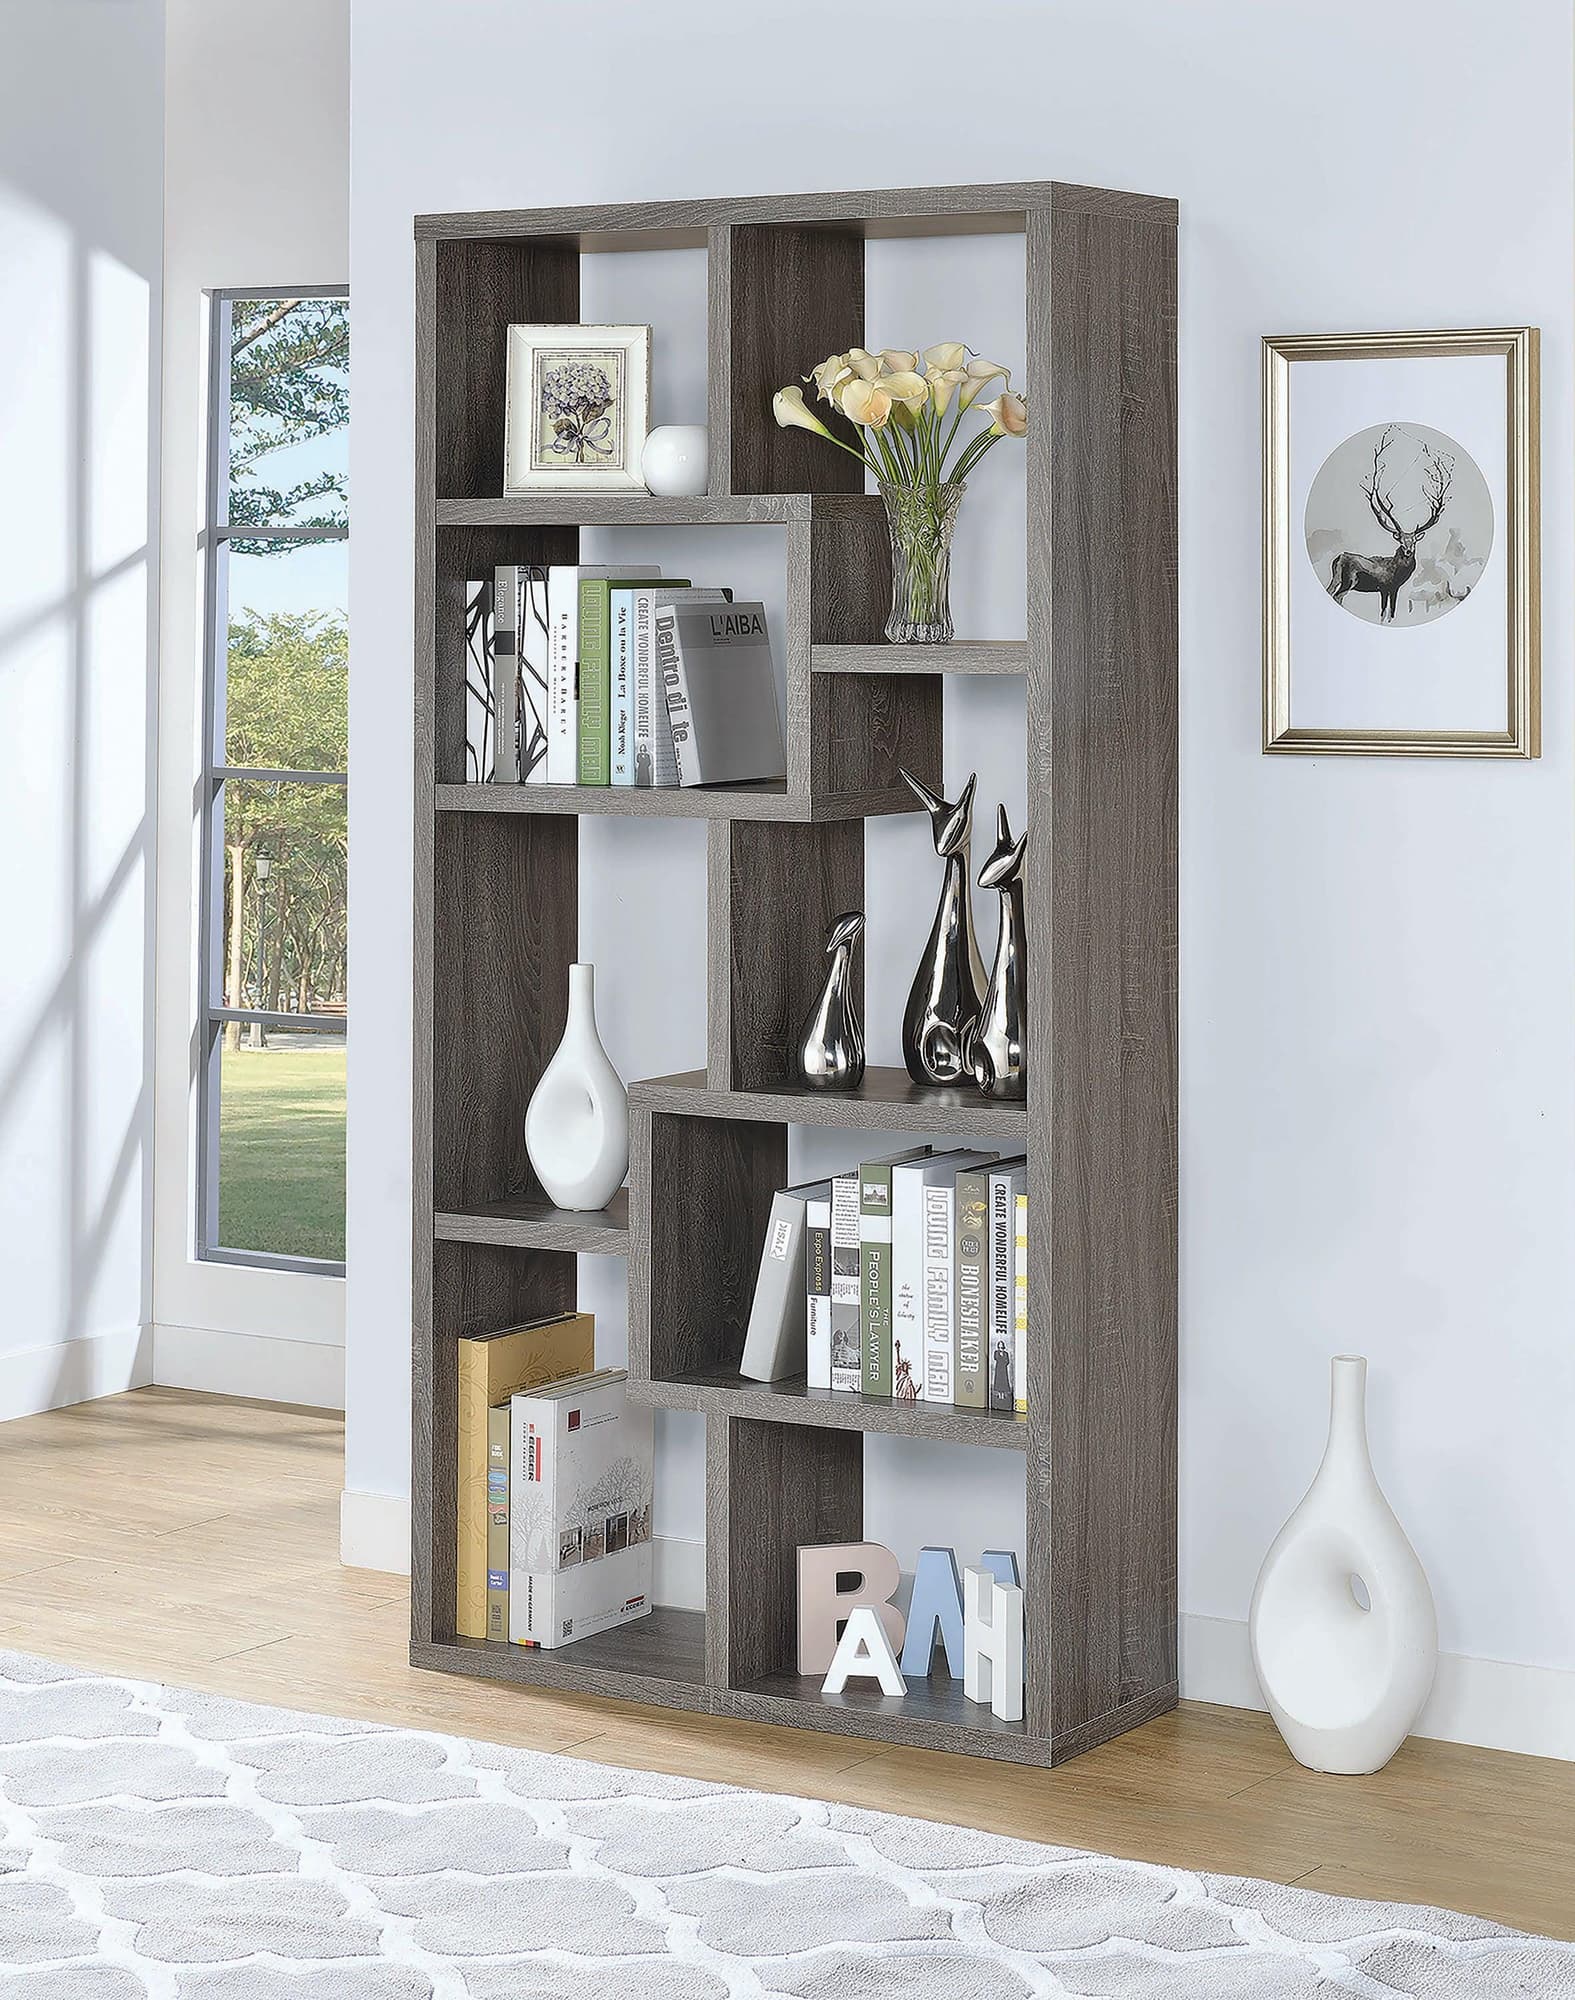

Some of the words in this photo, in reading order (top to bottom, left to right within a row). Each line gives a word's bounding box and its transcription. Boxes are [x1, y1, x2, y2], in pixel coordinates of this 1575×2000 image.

[496, 580, 508, 624] Elegance
[617, 606, 626, 623] Vie
[637, 597, 649, 630] CREATE
[617, 627, 626, 637] la
[710, 614, 763, 636] L'AIBA
[617, 656, 626, 681] Boxe
[637, 632, 649, 691] WONDERFUL
[656, 616, 680, 687] Dentro
[617, 684, 626, 698] La
[668, 691, 688, 713] di
[637, 692, 649, 738] HOMELIFE
[671, 721, 690, 743] te
[994, 1183, 1007, 1219] CREATE
[814, 1231, 824, 1255] Expo
[994, 1221, 1007, 1282] WONDERFUL
[814, 1255, 824, 1292] Express
[869, 1251, 881, 1319] PEOPLE'S
[809, 1297, 818, 1336] Furniture
[959, 1263, 980, 1373] BONESHAKER
[994, 1285, 1008, 1335] HOMELIFE
[869, 1322, 881, 1382] LAWYER
[820, 1605, 909, 1697] A
